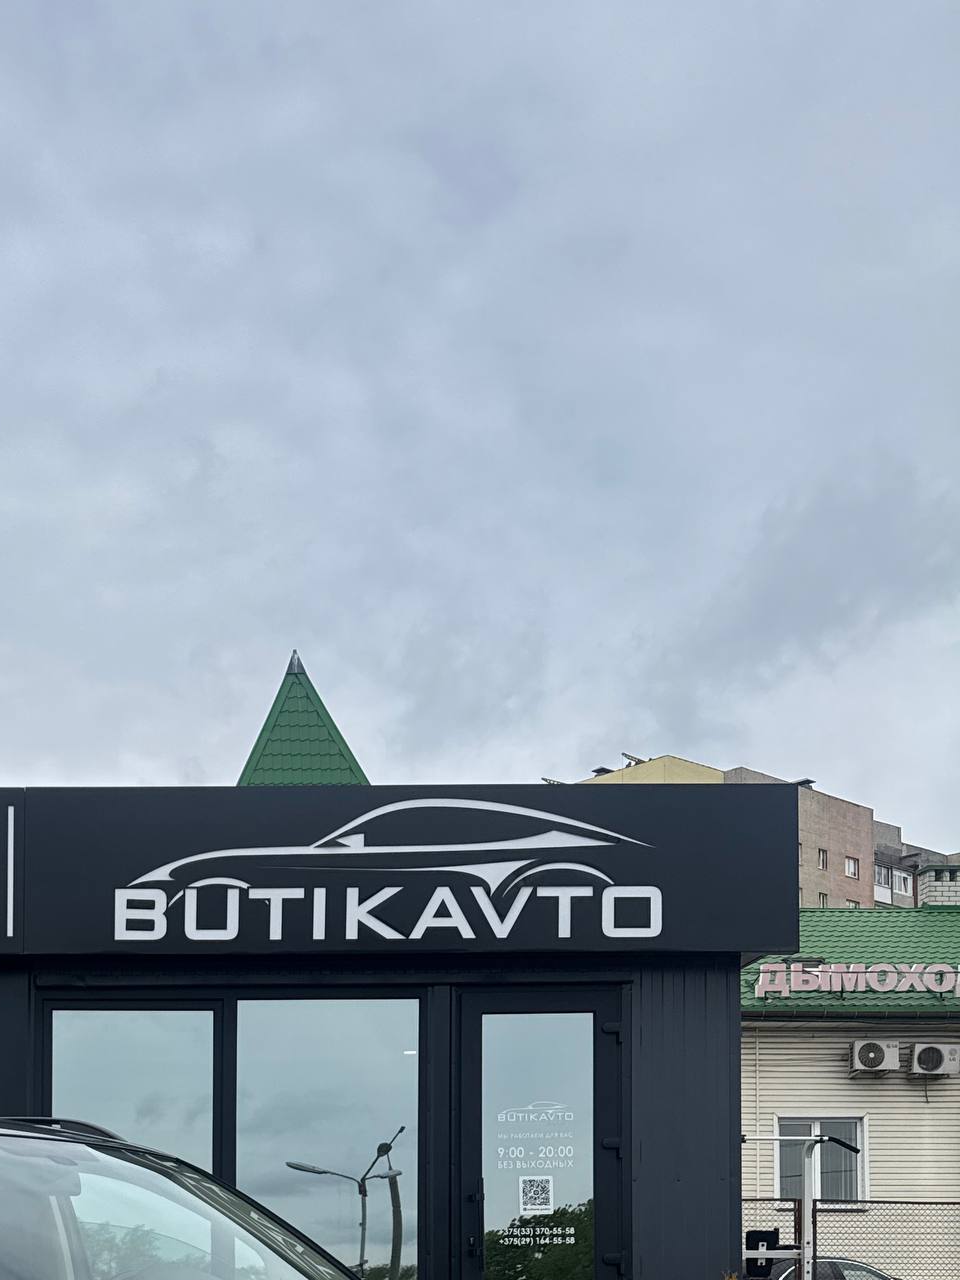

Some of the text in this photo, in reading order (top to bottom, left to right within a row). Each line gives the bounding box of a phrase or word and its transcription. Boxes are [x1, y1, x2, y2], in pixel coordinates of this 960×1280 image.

[114, 884, 663, 942] BUTIKAVTO
[755, 963, 960, 998] ДЫМОХО
[497, 1111, 574, 1122] BUTIKAVTO
[497, 1146, 525, 1158] 9:00
[538, 1145, 574, 1158] 20:00
[497, 1159, 574, 1169] БЕЗ ВЫХОДНЫХ
[535, 1226, 576, 1236] 370-55-58
[499, 1237, 534, 1247] +375(29)
